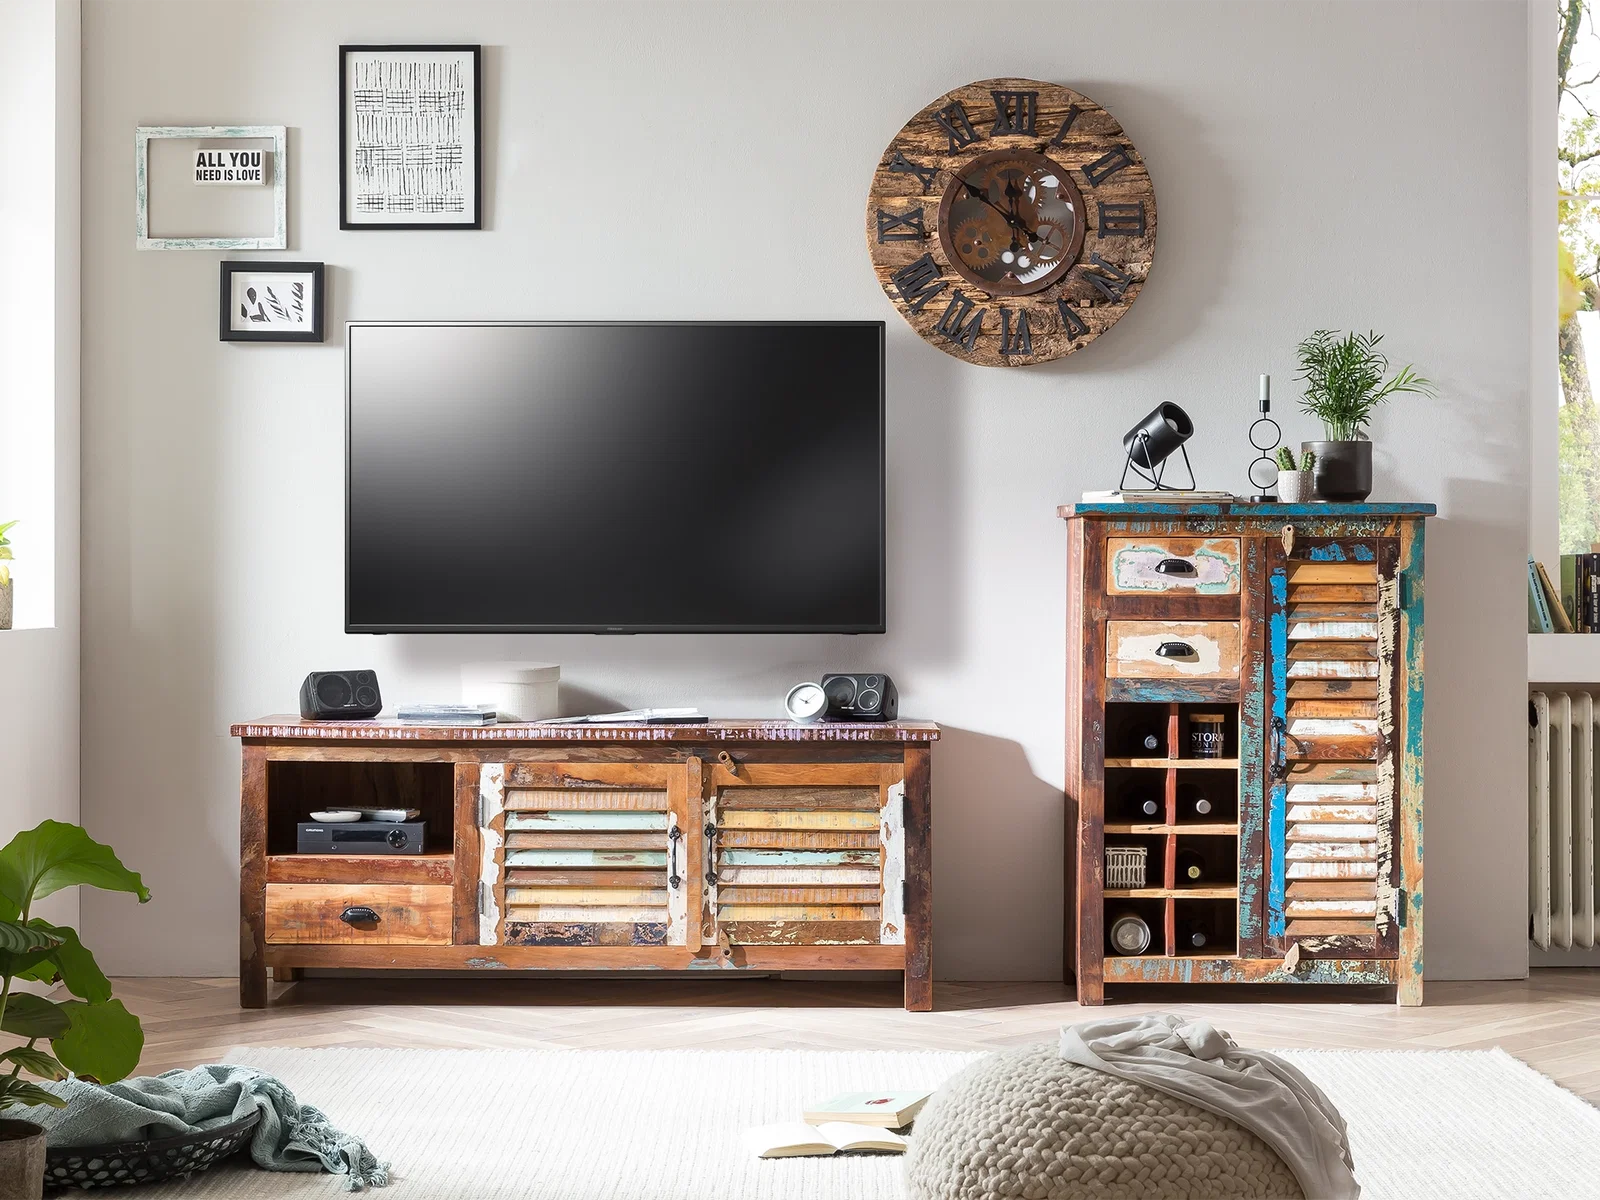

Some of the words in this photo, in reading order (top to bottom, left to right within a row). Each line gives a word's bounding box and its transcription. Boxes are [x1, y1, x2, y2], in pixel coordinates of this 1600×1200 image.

[931, 101, 980, 155] XI
[990, 91, 1039, 137] XII
[1051, 104, 1079, 147] I
[196, 152, 225, 167] ALL
[229, 152, 260, 167] YOU
[196, 169, 221, 181] NEED
[224, 169, 233, 181] IS
[236, 169, 260, 181] LOVE
[888, 152, 940, 190] X
[1081, 144, 1134, 188] II
[1098, 201, 1145, 239] III
